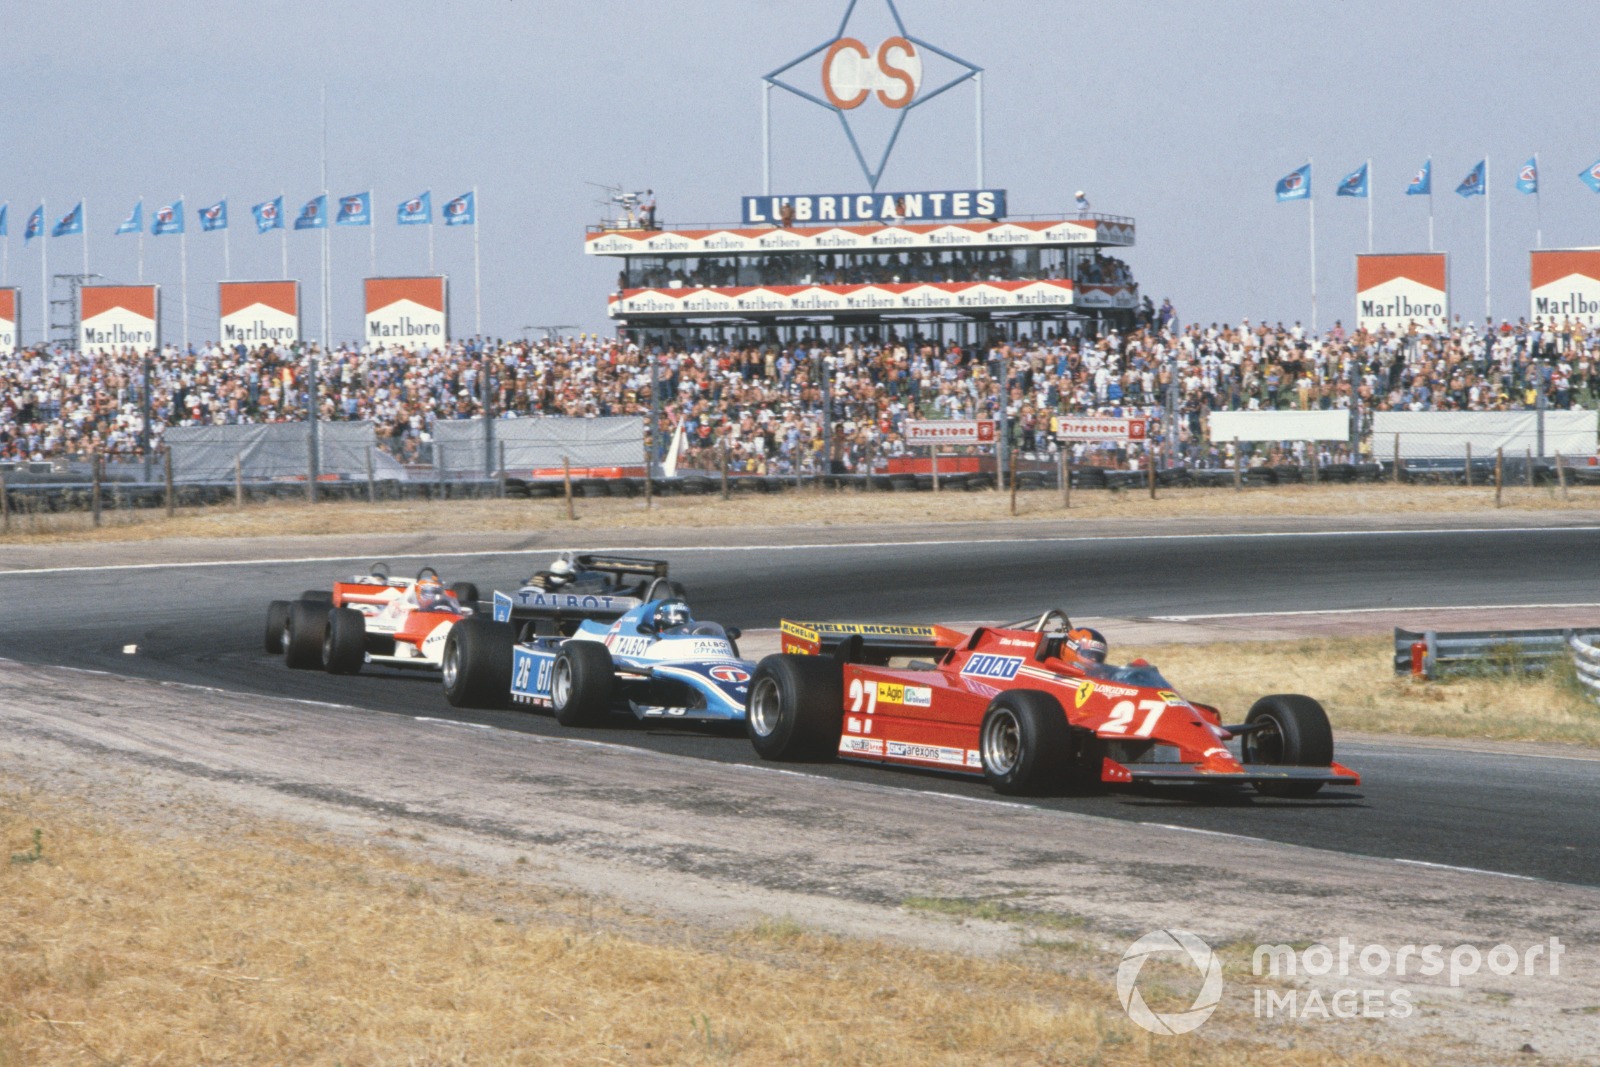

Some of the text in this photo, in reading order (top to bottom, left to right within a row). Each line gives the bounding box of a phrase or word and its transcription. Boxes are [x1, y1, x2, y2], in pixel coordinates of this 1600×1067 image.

[822, 36, 915, 110] CS
[749, 192, 995, 222] LUBRICANTES
[593, 241, 633, 251] Marlboro
[648, 240, 689, 250] Marlboro
[704, 239, 744, 249] Marlboro
[760, 238, 800, 249] Marlboro
[816, 236, 856, 248] Marlboro
[872, 234, 913, 246] Marlboro
[929, 232, 971, 244] Marlboro
[987, 231, 1029, 243] Marlboro
[1045, 229, 1088, 241] Marlboro
[628, 300, 675, 312] Marlboro
[683, 299, 729, 312] Marlboro
[738, 298, 784, 310] Marlboro
[792, 296, 839, 310] Marlboro
[847, 294, 895, 308] Marlboro
[902, 292, 951, 308] Marlboro
[957, 292, 1007, 306] Marlboro
[1016, 290, 1066, 304] Marlboro
[1361, 296, 1442, 318] Marlboro
[1536, 292, 1600, 314] Marlbo
[86, 324, 151, 343] Marlboro
[224, 321, 294, 340] Marlboro
[370, 317, 440, 337] Marlboro
[912, 426, 975, 436] Firestone
[1062, 423, 1126, 433] Firestone
[518, 593, 613, 608] TALBOT
[783, 623, 815, 640] MICHELIN
[864, 625, 932, 636] MICHELIN
[615, 638, 652, 656] TALBOT
[516, 656, 531, 689] 26
[966, 657, 1019, 676] FIAT
[886, 685, 902, 700] Agip
[1094, 684, 1139, 696] LONGINES
[646, 707, 686, 716] 26
[1098, 700, 1168, 736] 27
[906, 746, 940, 758] arexons
